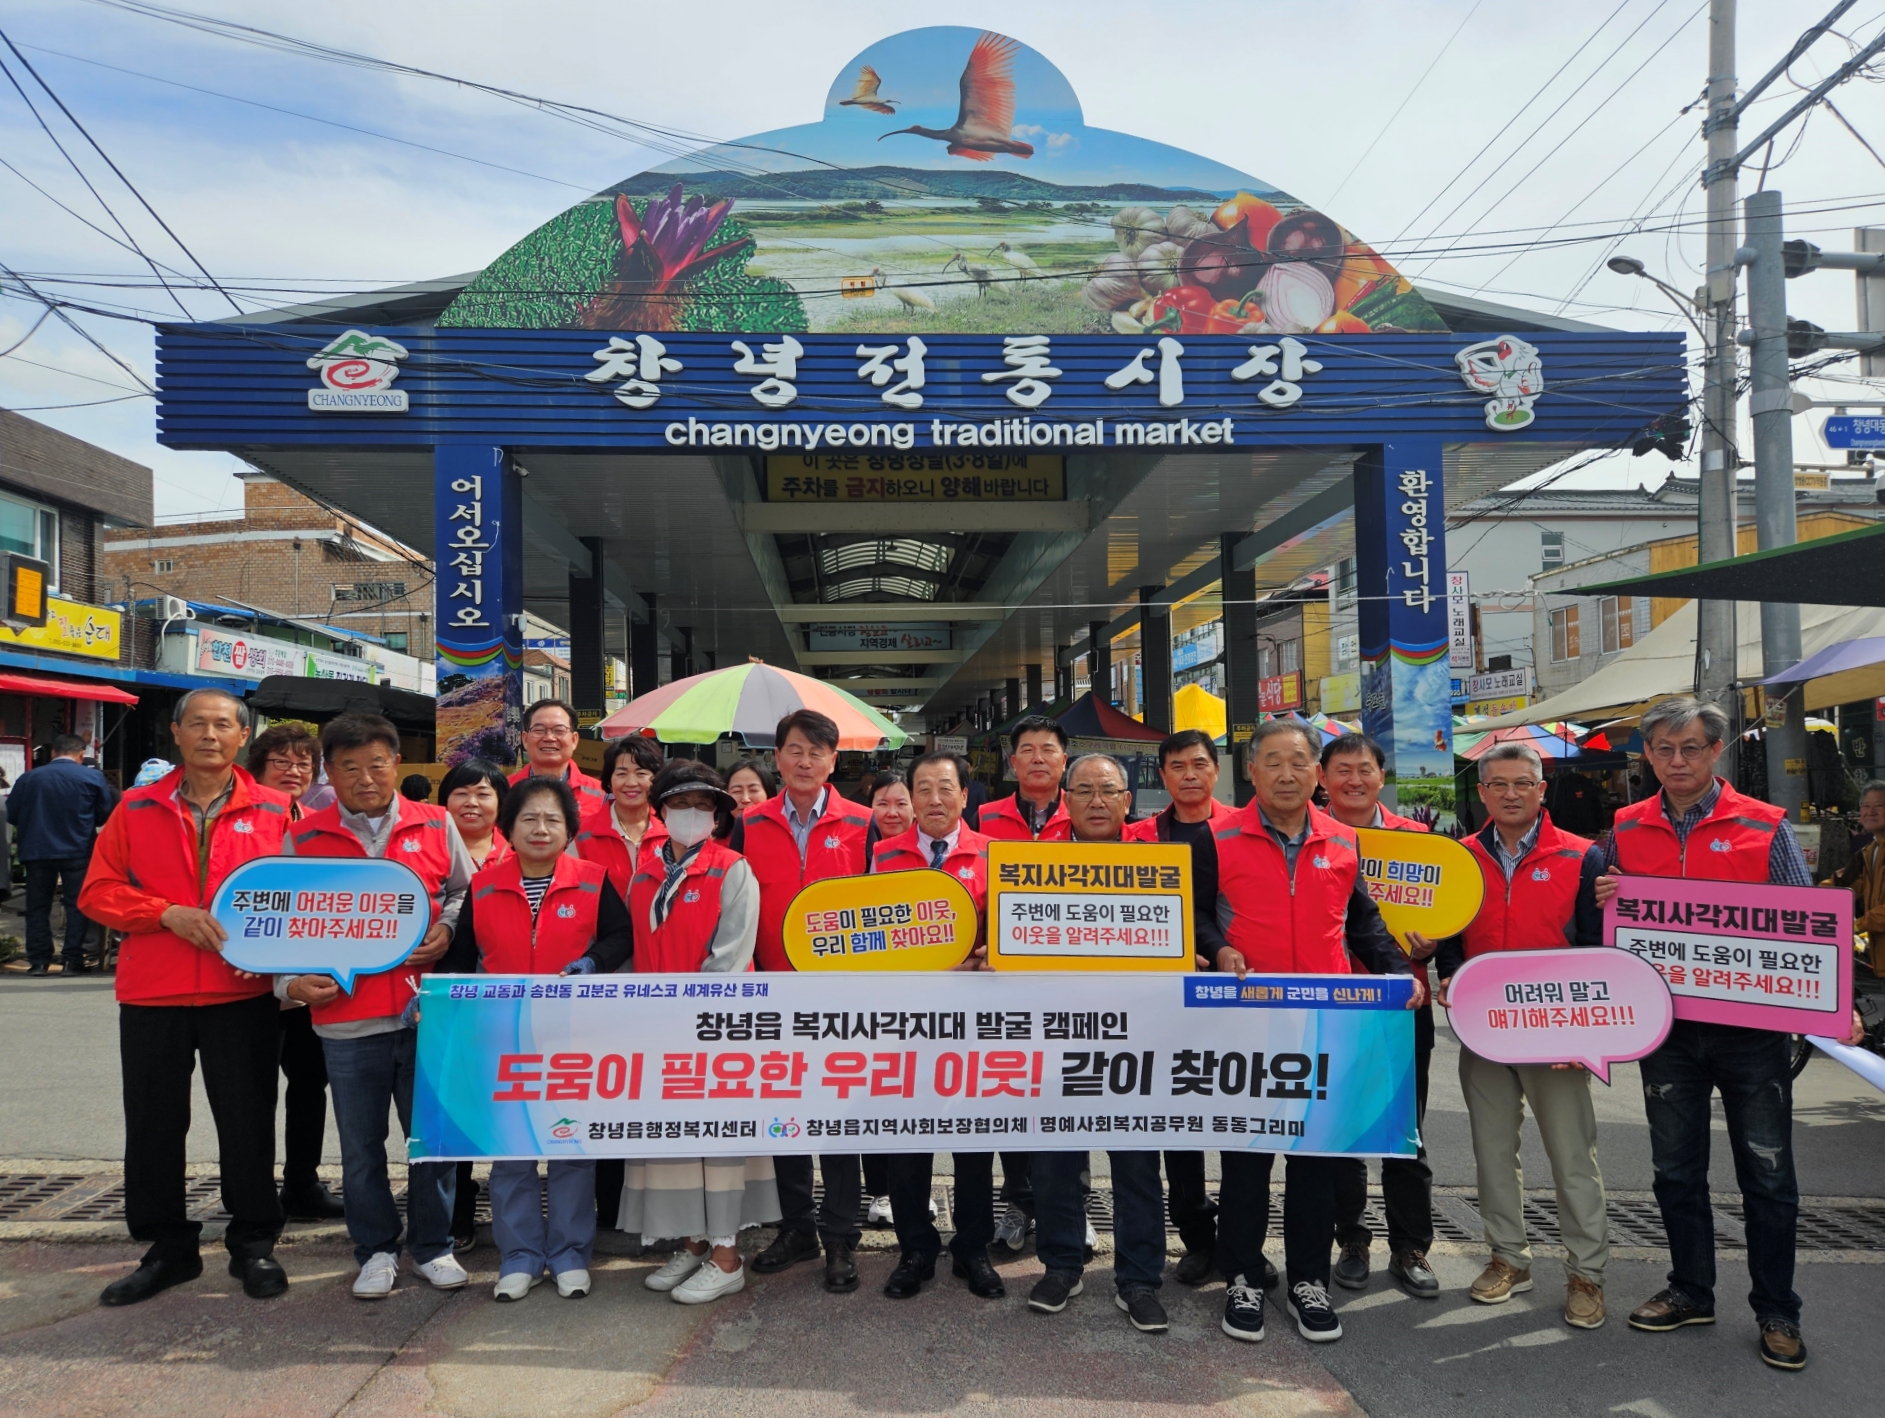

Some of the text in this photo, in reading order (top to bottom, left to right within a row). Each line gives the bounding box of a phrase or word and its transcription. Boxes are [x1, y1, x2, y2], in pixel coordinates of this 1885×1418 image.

[584, 335, 1323, 409] 창녕전통시장
[312, 394, 402, 407] CHANGNYEONG
[664, 416, 1235, 450] changnyeong traditional market
[781, 476, 839, 498] 주차를
[844, 476, 935, 498] 금지하오니
[448, 475, 490, 628] 어서오십시오
[1397, 469, 1436, 615] 환영합니다
[84, 615, 111, 646] 순대
[860, 637, 897, 649] 지역경제
[1494, 672, 1523, 690] 노래교실
[998, 863, 1182, 889] 복지사각지대발굴
[1386, 861, 1441, 885] 희망이
[232, 891, 415, 915] 주변에 어려운 이웃을
[1365, 880, 1434, 907] 주세요!!
[806, 899, 957, 935] 도움이 필요한 이웃,
[1011, 903, 1170, 924] 주변에 도움이 필요한
[1615, 897, 1838, 938] 복지사각지대발굴
[243, 917, 398, 939] 같이 찾아주세요!!
[812, 924, 955, 957] 우리 함께 찾아요!!
[1011, 926, 1170, 948] 이웃을 알려주세요!!!
[1629, 938, 1822, 975] 주변에 도움이 필요한
[450, 983, 769, 999] 창녕 교동과 송현동 고분군 유네스코 세계유산 등재
[1195, 985, 1382, 1003] 창녕을 새롭게 군민을 신나게!
[1505, 980, 1611, 1004] 어려워 말고
[1692, 967, 1820, 999] 알려주세요!!!
[696, 1011, 1129, 1041] 창녕읍 복지사각지대 발굴 캠페인
[1487, 1005, 1635, 1030] 얘기해주세요!!!
[492, 1049, 1329, 1102] 도움이 필요한 우리 이웃! 같이 찾아요!
[588, 1115, 1305, 1140] 창녕읍행정복지센터 창녕읍지역사회보장협의체 명예사회복지공무원 동동그리미
